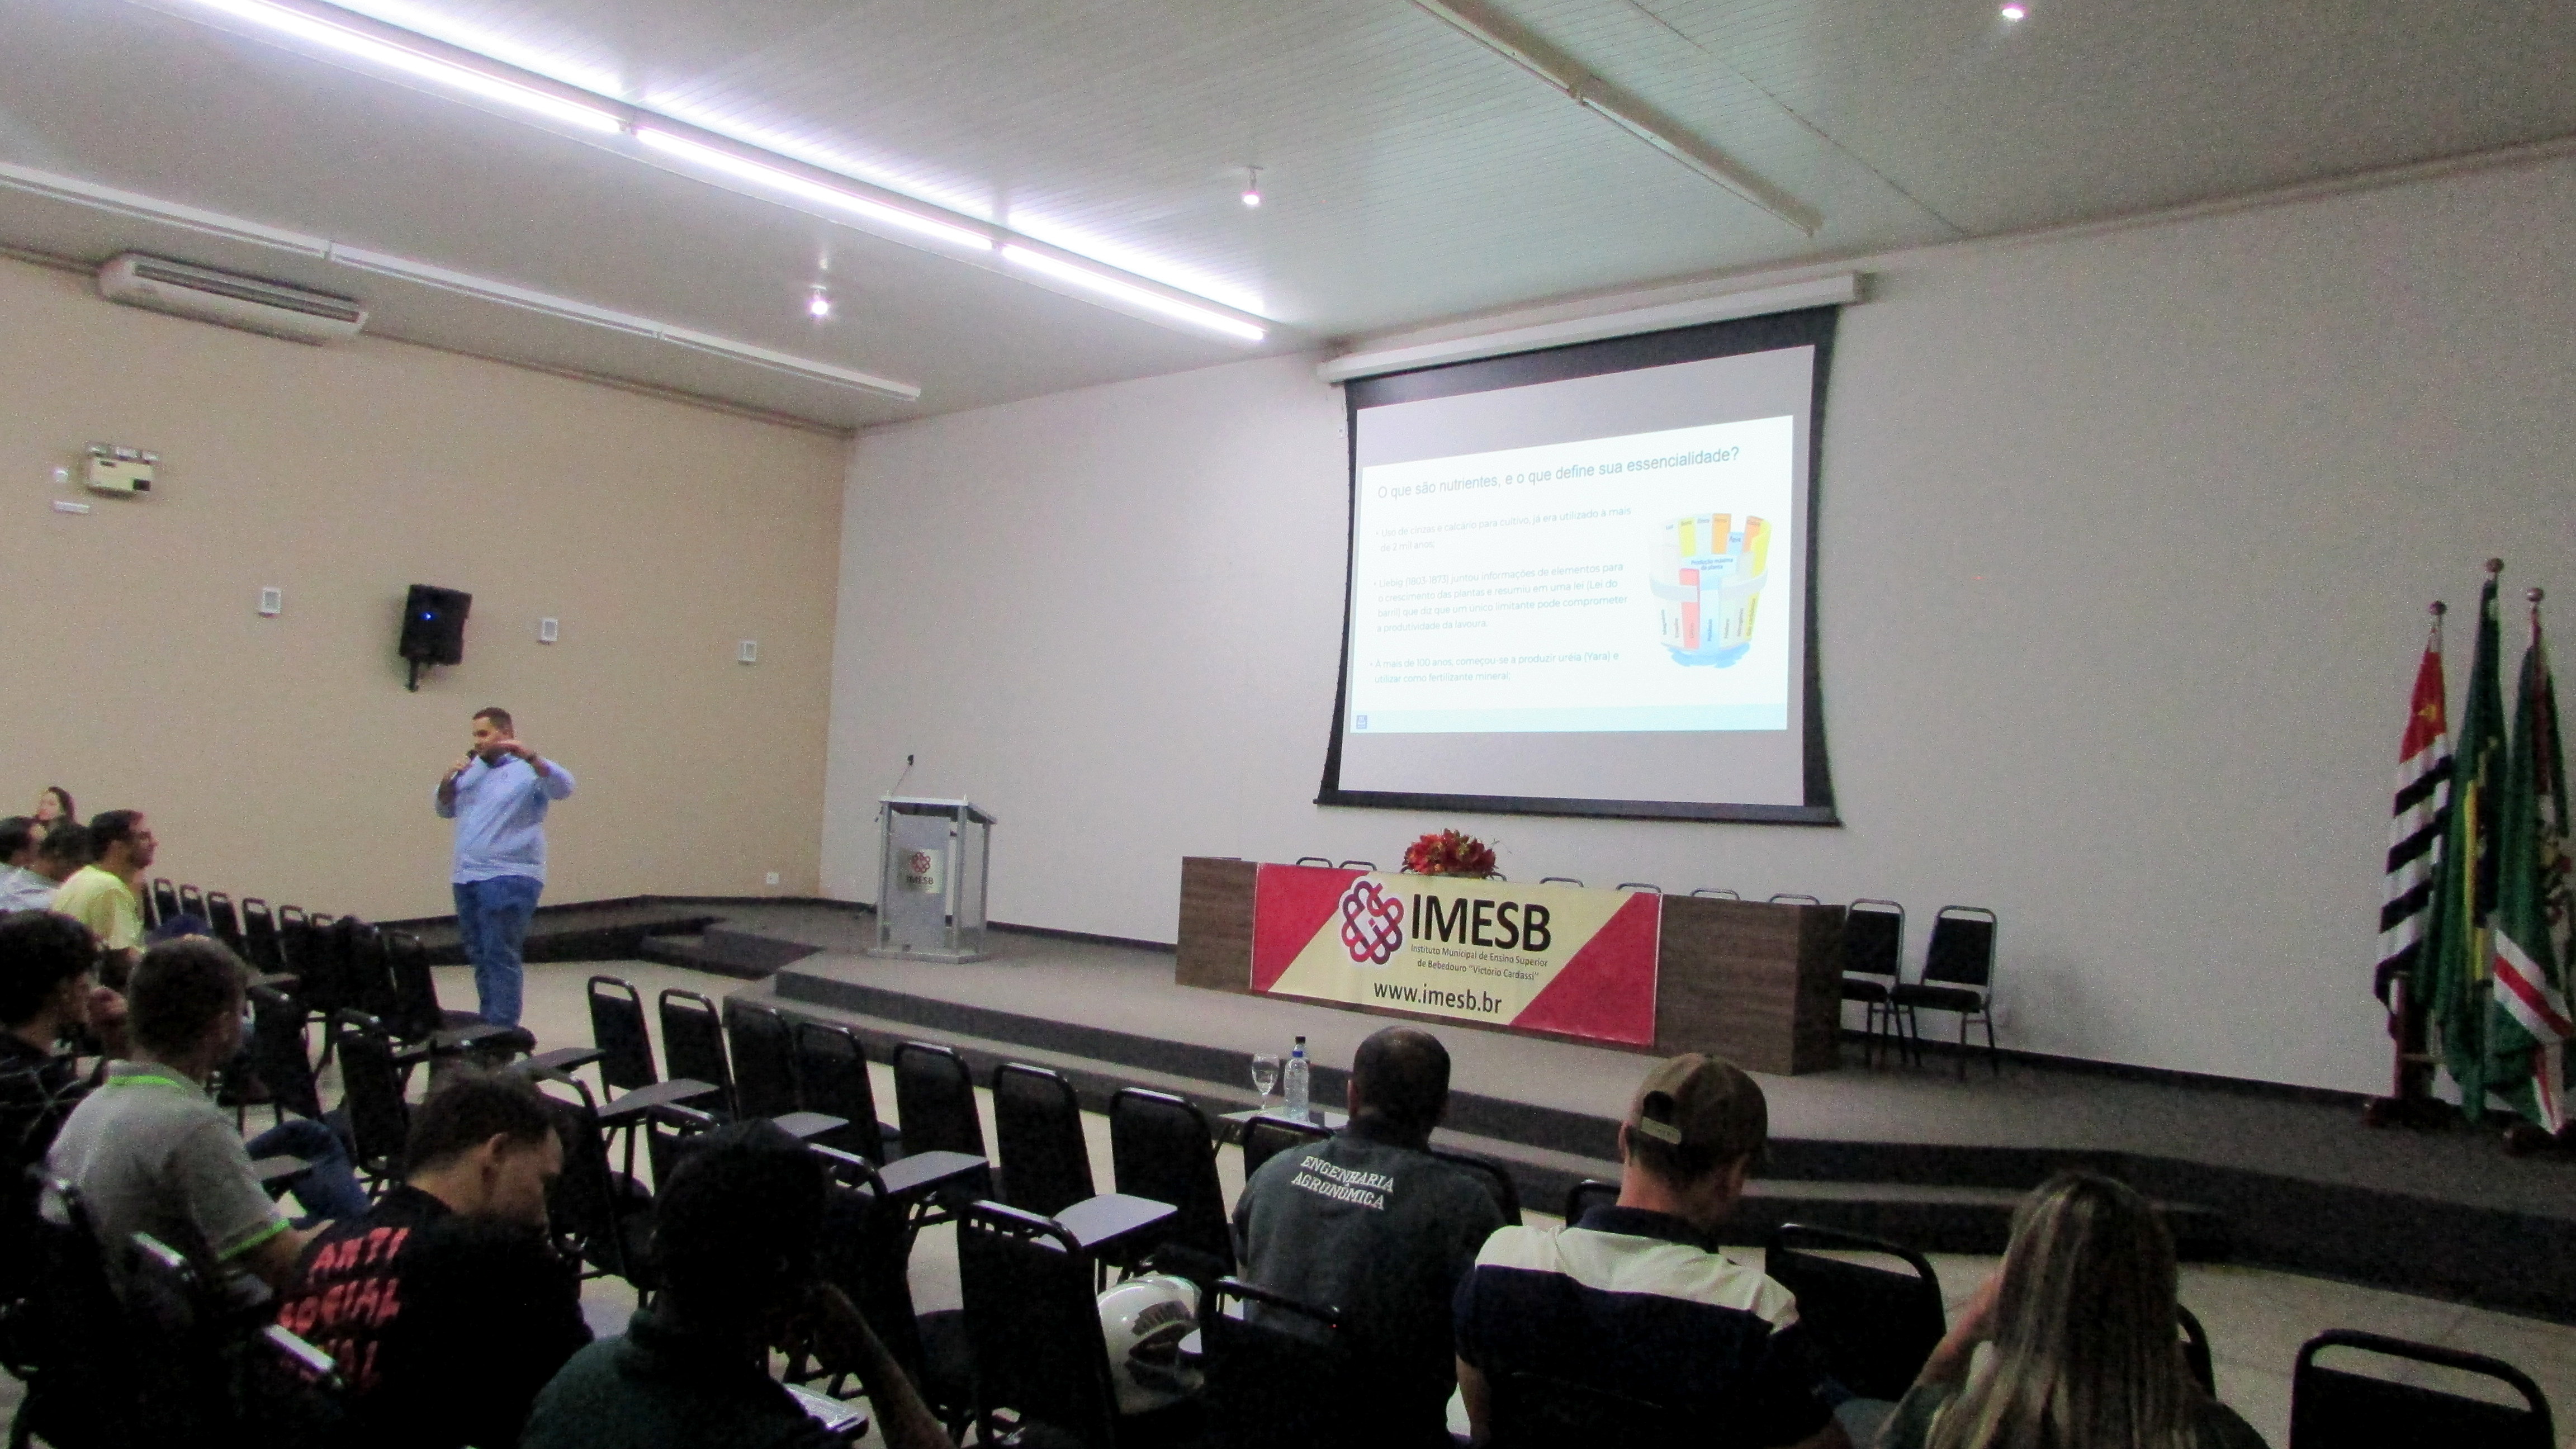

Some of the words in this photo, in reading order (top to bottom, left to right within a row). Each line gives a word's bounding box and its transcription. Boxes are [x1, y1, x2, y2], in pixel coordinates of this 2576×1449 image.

[1378, 486, 1387, 498] O
[1391, 486, 1412, 500] que
[1415, 482, 1436, 495] são
[1439, 476, 1500, 492] nutrientes,
[1505, 475, 1513, 485] e
[1517, 473, 1524, 484] o
[1528, 470, 1551, 486] que
[1555, 464, 1594, 479] define
[1599, 463, 1622, 475] sua
[1627, 446, 1739, 472] essencialidade?
[1410, 525, 1435, 534] cinzas
[1445, 522, 1476, 531] calcário
[1479, 520, 1497, 529] para
[1500, 517, 1531, 527] cultivo,
[1532, 514, 1540, 525] já
[1559, 510, 1598, 522] utilizado
[1609, 506, 1631, 516] mais
[1393, 543, 1397, 551] 2
[1399, 542, 1412, 550] mil
[1379, 579, 1403, 588] Liebig
[1450, 574, 1479, 584] juntou
[1481, 569, 1536, 581] informações
[1538, 568, 1549, 576] de
[1551, 565, 1600, 576] elementos
[1603, 564, 1623, 574] para
[1385, 592, 1435, 602] crescimento
[1437, 590, 1452, 599] das
[1454, 588, 1485, 599] plantas
[1495, 586, 1530, 595] resumiu
[1550, 583, 1571, 591] uma
[1574, 581, 1584, 590] lei
[1587, 580, 1603, 591] (Lei
[1606, 579, 1618, 588] do
[1403, 608, 1418, 617] que
[1420, 607, 1432, 615] diz
[1434, 607, 1450, 615] que
[1469, 603, 1493, 612] único
[1495, 601, 1535, 611] limitante
[1538, 599, 1560, 610] pode
[1562, 595, 1628, 607] comprometer
[1384, 622, 1440, 633] produtividade
[1442, 621, 1453, 629] da
[1455, 656, 1509, 667] começou-se
[1518, 654, 1556, 665] produzir
[1559, 654, 1581, 662] uréia
[1584, 651, 1610, 662] (Yara)
[1429, 673, 1473, 682] fertilizante
[1412, 894, 1551, 952] IMESB
[1411, 944, 1440, 955] Instituto
[1442, 948, 1477, 960] Municipal
[1479, 952, 1488, 960] de
[1490, 953, 1514, 963] Ensino
[1516, 956, 1548, 967] Superior
[1417, 959, 1426, 968] de
[1428, 961, 1466, 972] Bebedouro
[1374, 982, 1502, 1014] www.imesb.br
[1300, 1156, 1394, 1193] ENGENHARIA
[1291, 1171, 1384, 1210] AGRONÔMICA
